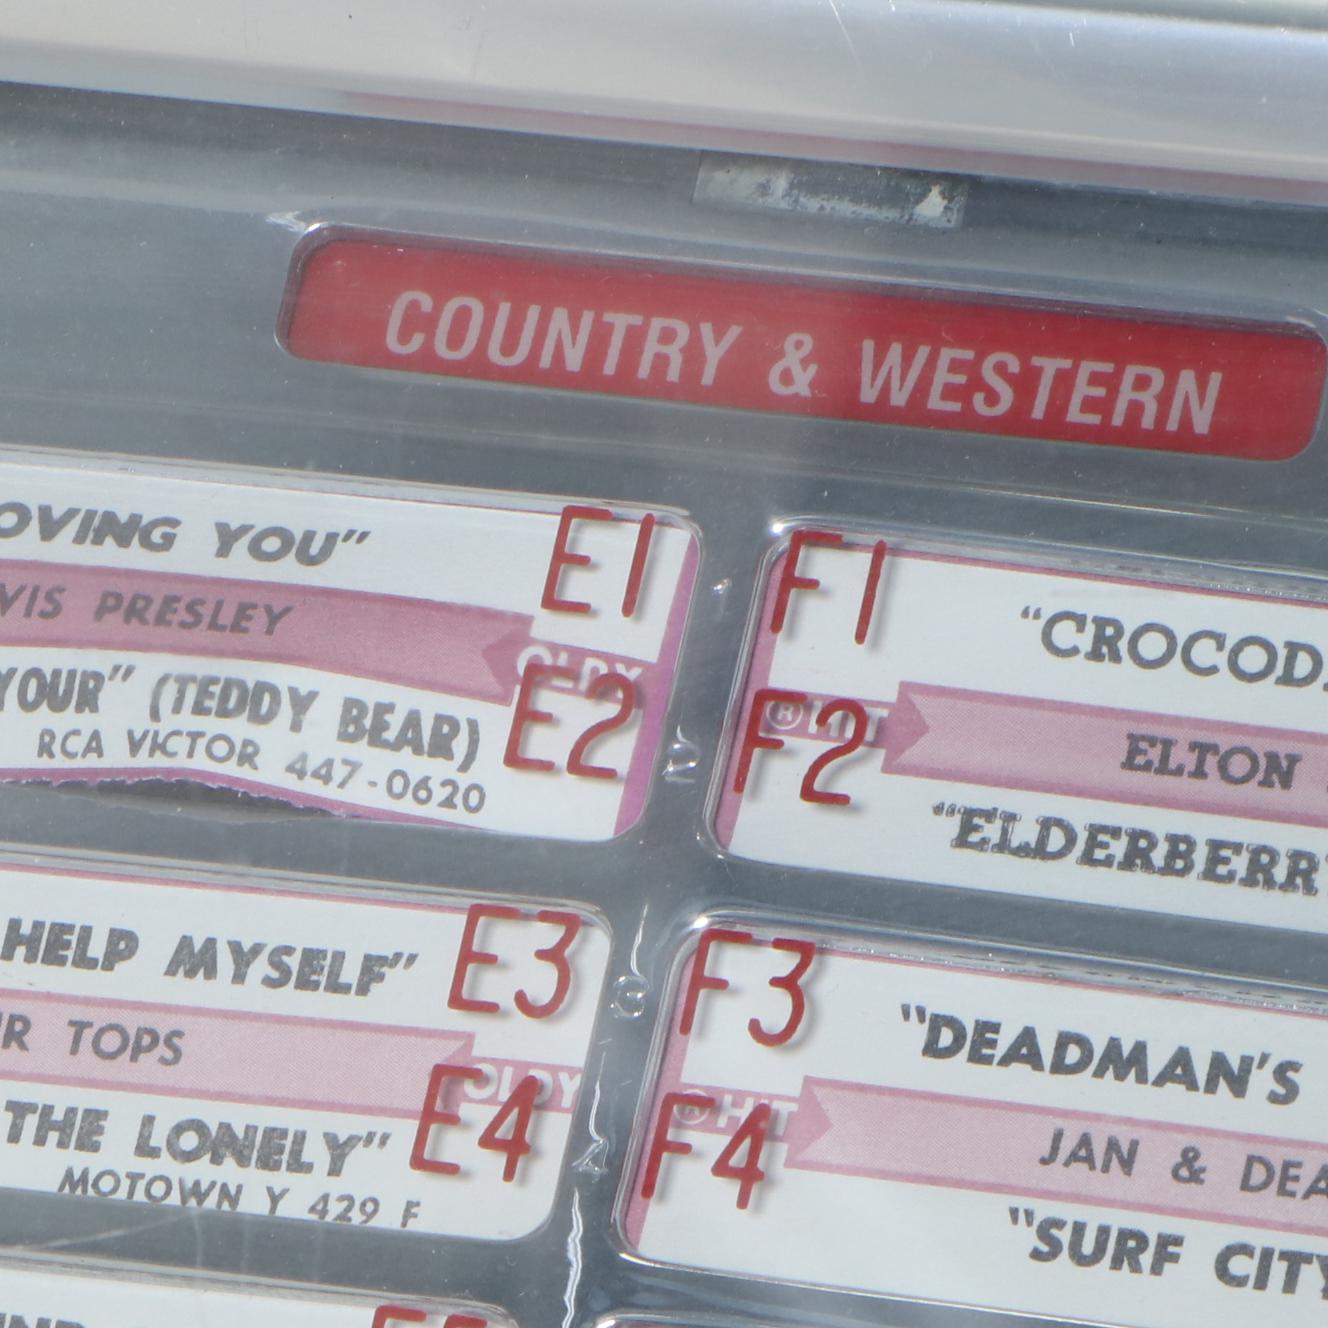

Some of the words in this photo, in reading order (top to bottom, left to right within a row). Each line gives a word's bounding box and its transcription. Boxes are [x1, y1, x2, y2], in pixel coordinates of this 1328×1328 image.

[384, 290, 739, 386] COUNTRY
[768, 333, 819, 396] &
[862, 342, 1223, 436] WESTERN
[214, 521, 372, 567] YOU"
[540, 505, 655, 618] E1
[769, 531, 887, 644] F1
[94, 590, 295, 636] PRESLEY
[36, 727, 105, 760] RCA
[126, 728, 261, 771] VICTOR
[283, 751, 487, 814] 447-0620
[149, 672, 320, 734] (TEDDY
[336, 696, 481, 774] BEAR)
[503, 662, 641, 780] E2
[732, 689, 868, 805] F2
[1119, 731, 1303, 791] ELTON
[0, 916, 140, 972] HELP
[163, 933, 419, 997] MYSELF"
[447, 905, 580, 1019] E3
[678, 929, 816, 1048] F3
[67, 1018, 186, 1067] TOPS
[900, 1002, 1304, 1106] "DEADMAN'S
[4, 1098, 110, 1154] THE
[133, 1113, 392, 1178] LONELY"
[409, 1066, 542, 1182] E4
[642, 1094, 771, 1210] F4
[1038, 1127, 1141, 1178] JAN
[1170, 1144, 1208, 1186] &
[1008, 1205, 1186, 1277] "SURF
